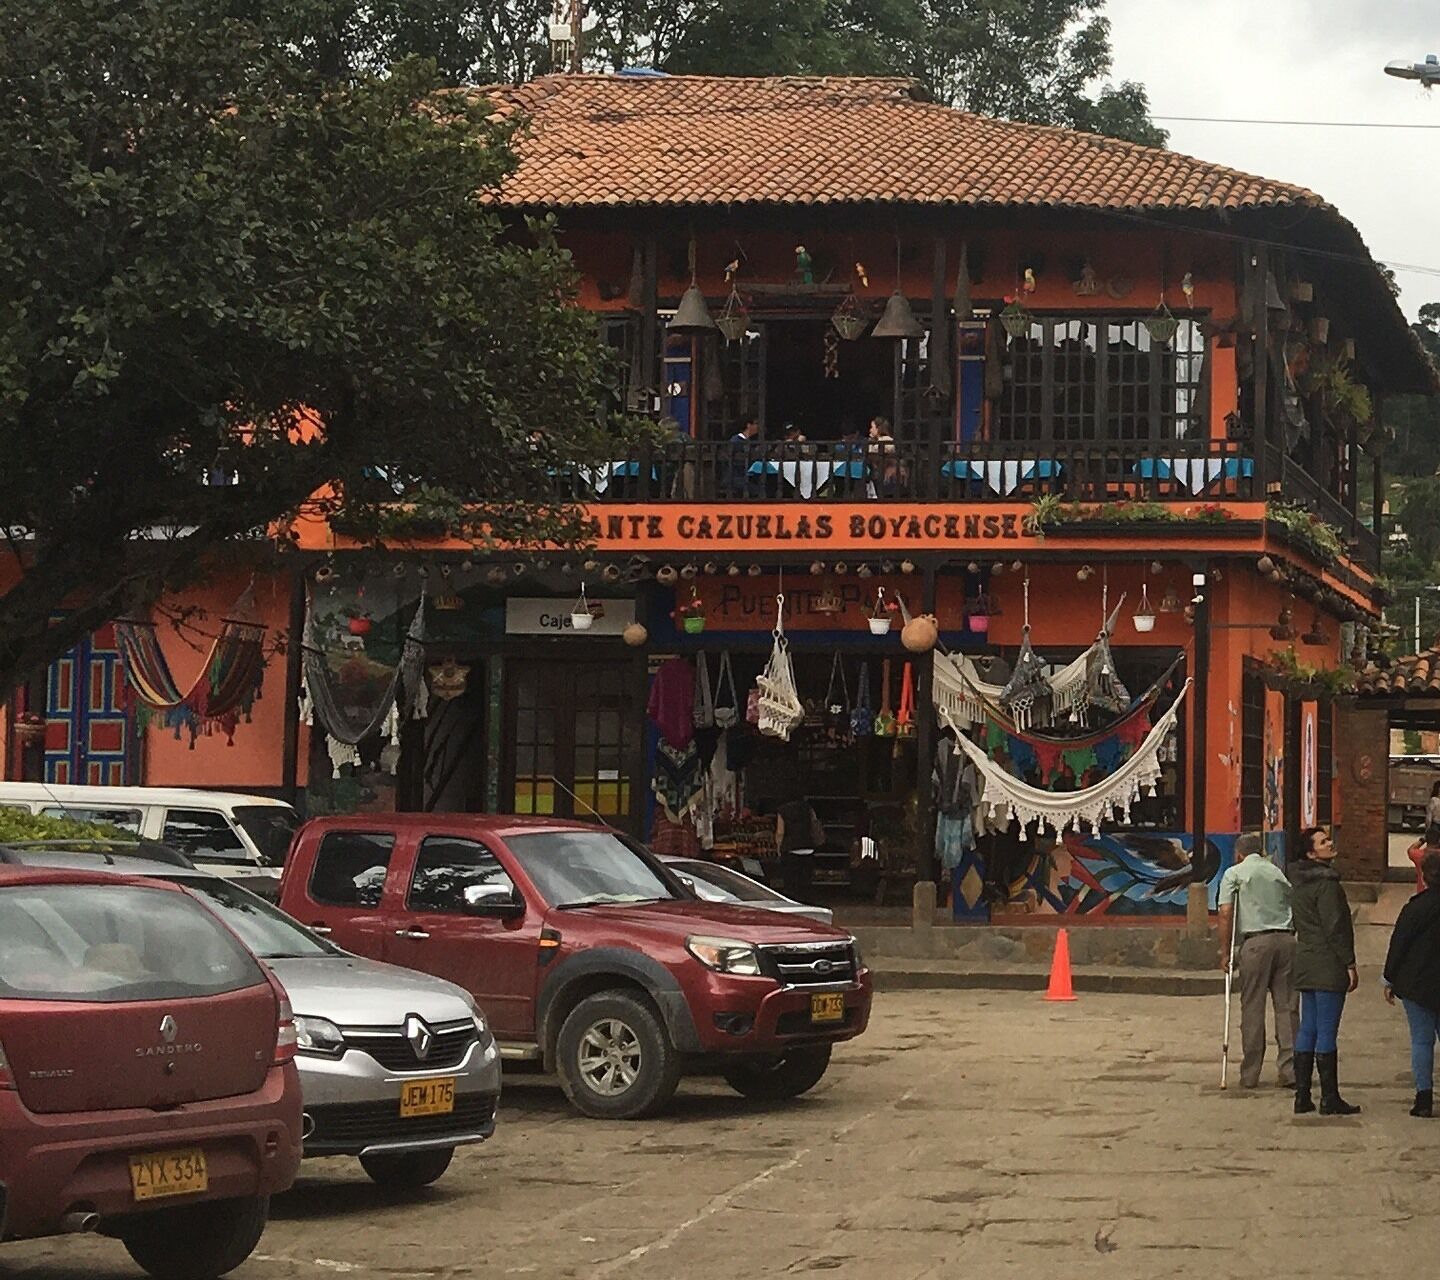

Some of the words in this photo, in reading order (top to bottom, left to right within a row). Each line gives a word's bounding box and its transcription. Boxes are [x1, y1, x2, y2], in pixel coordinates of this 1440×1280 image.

[677, 514, 833, 539] CAZUELAS
[430, 1083, 453, 1105] 175
[134, 1159, 168, 1187] ZYX
[171, 1154, 204, 1181] 334
